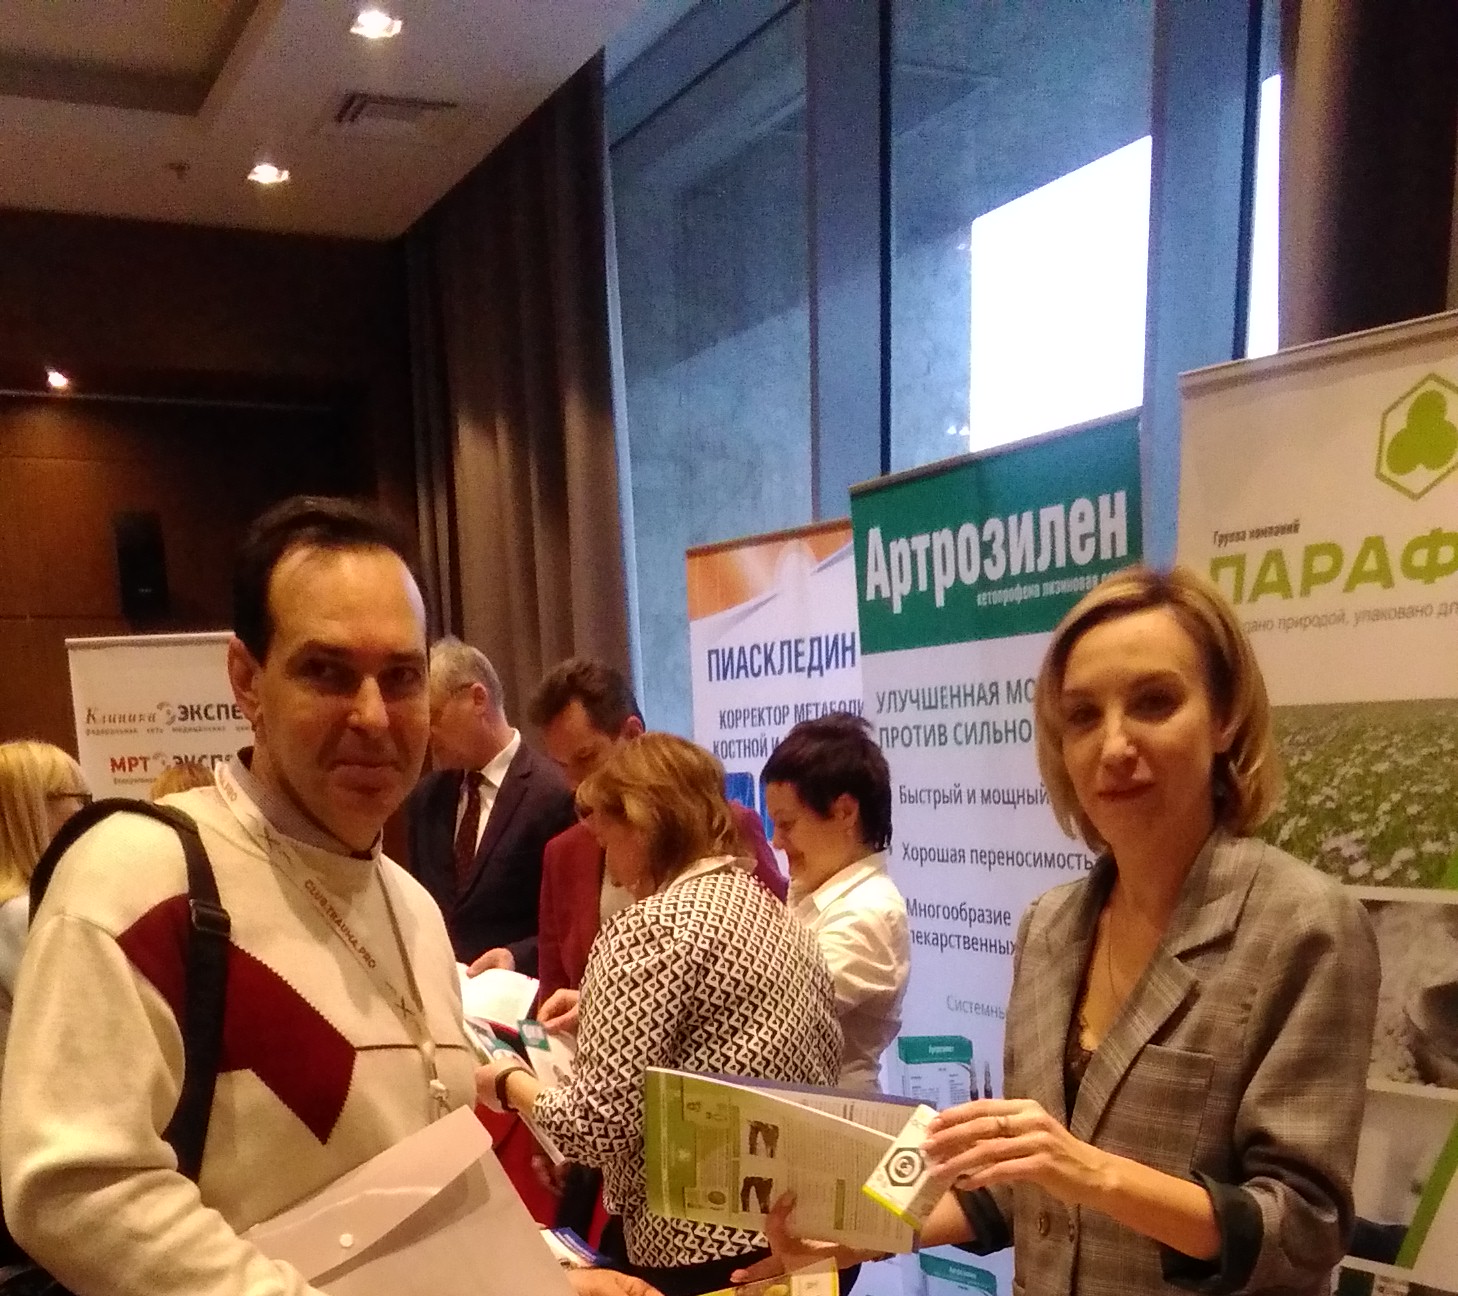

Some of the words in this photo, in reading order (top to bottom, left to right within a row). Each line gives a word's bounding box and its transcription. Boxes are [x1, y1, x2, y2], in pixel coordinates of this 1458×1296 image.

[866, 490, 1128, 614] Артрозилен
[1213, 531, 1247, 548] Группа
[707, 631, 856, 682] ПИАСКЛЕДИН
[876, 681, 999, 713] УЛУЧШЕННАЯ
[719, 704, 790, 730] КОРРЕКТОР
[713, 732, 769, 760] КОСТНОЙ
[879, 723, 948, 749] ПРОТИВ
[954, 718, 1033, 745] СИЛЬНО
[110, 756, 150, 773] МРТ
[899, 783, 963, 810] Быстрый
[967, 789, 976, 805] и
[903, 842, 966, 866] Хорошая
[970, 849, 1094, 871] переносимость
[906, 897, 1011, 928] Многообразие
